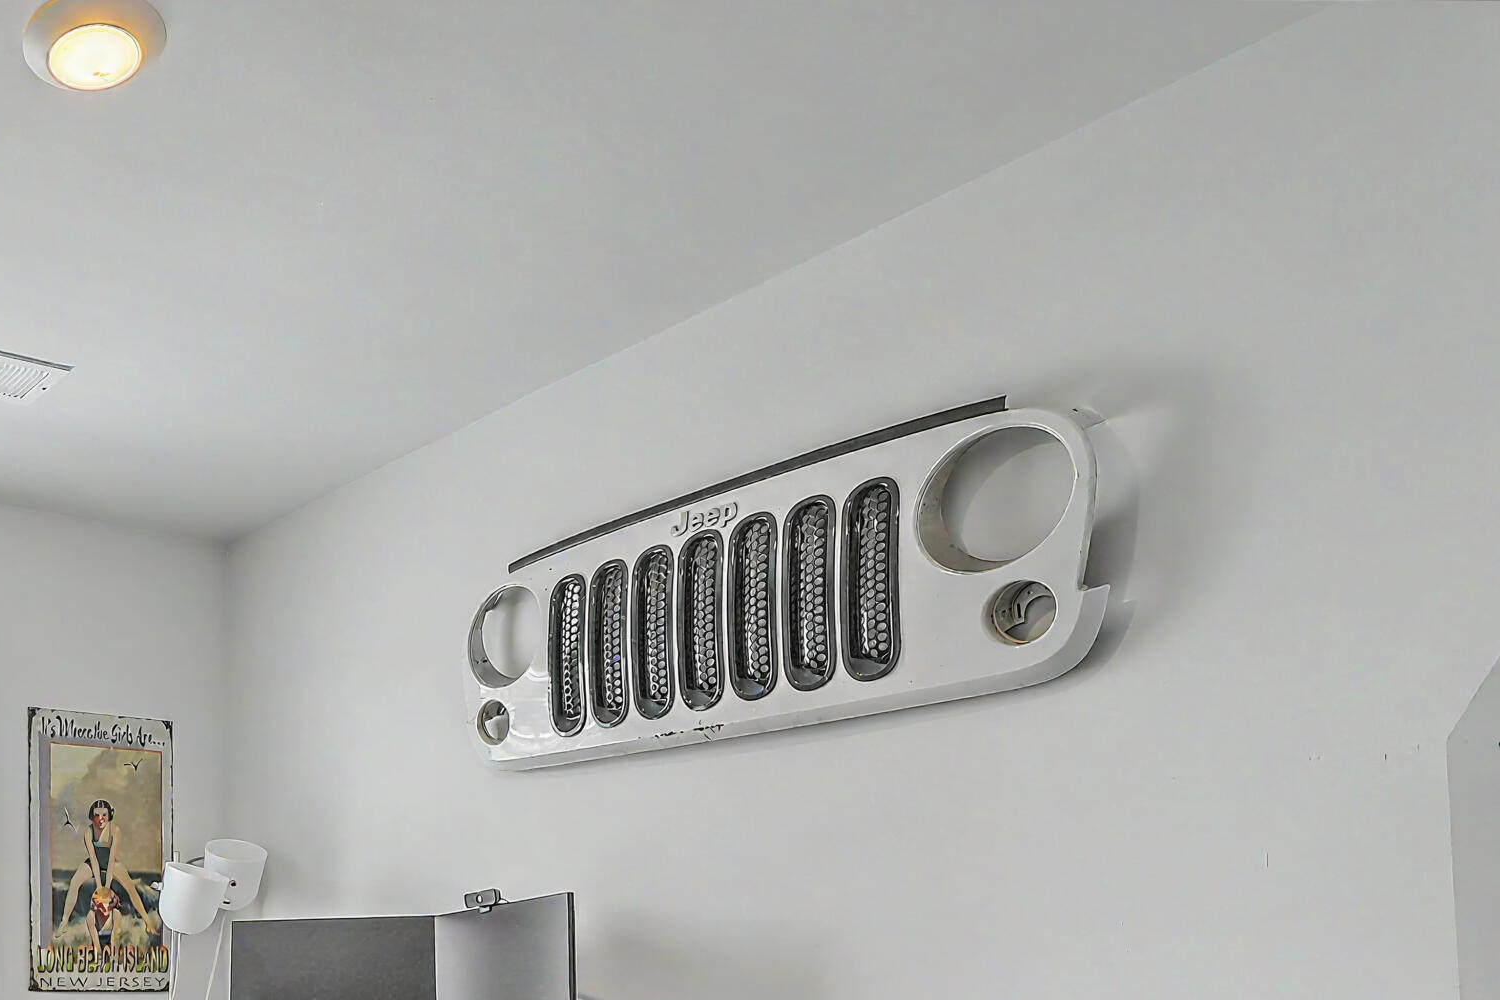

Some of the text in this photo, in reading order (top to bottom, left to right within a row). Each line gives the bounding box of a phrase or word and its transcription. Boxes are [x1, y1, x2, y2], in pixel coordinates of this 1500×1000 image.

[671, 501, 738, 537] Jeep
[37, 944, 169, 973] LONG BEACH ISLAND
[40, 976, 165, 988] NEW JERSEY
